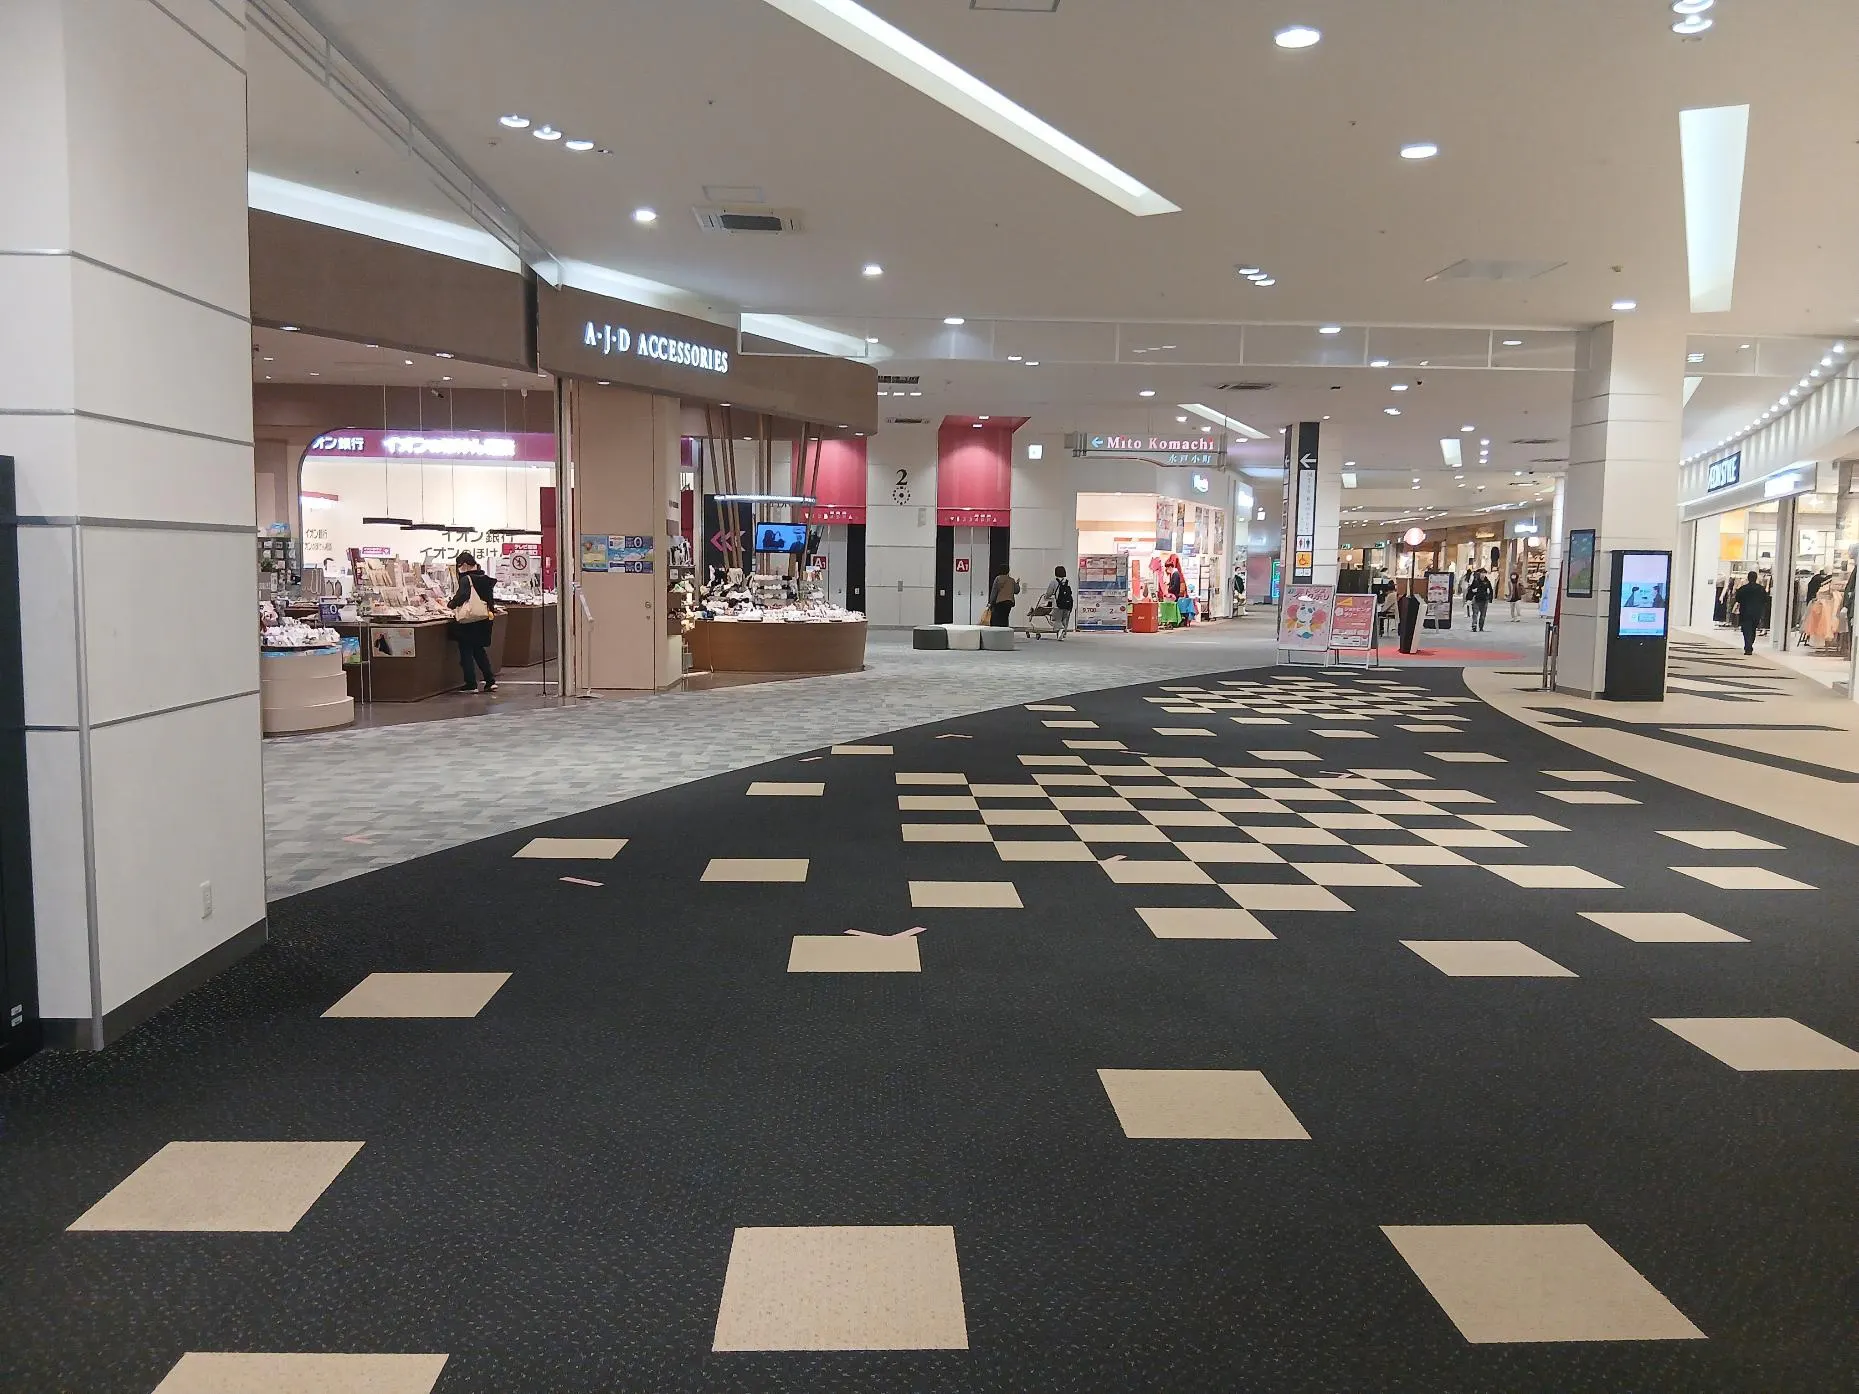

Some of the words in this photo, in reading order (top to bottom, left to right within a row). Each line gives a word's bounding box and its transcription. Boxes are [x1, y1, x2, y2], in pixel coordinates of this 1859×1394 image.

[638, 333, 728, 374] ACCESSORIES
[1107, 435, 1142, 449] Mito
[1148, 437, 1214, 450] Komachi
[896, 468, 908, 486] 2
